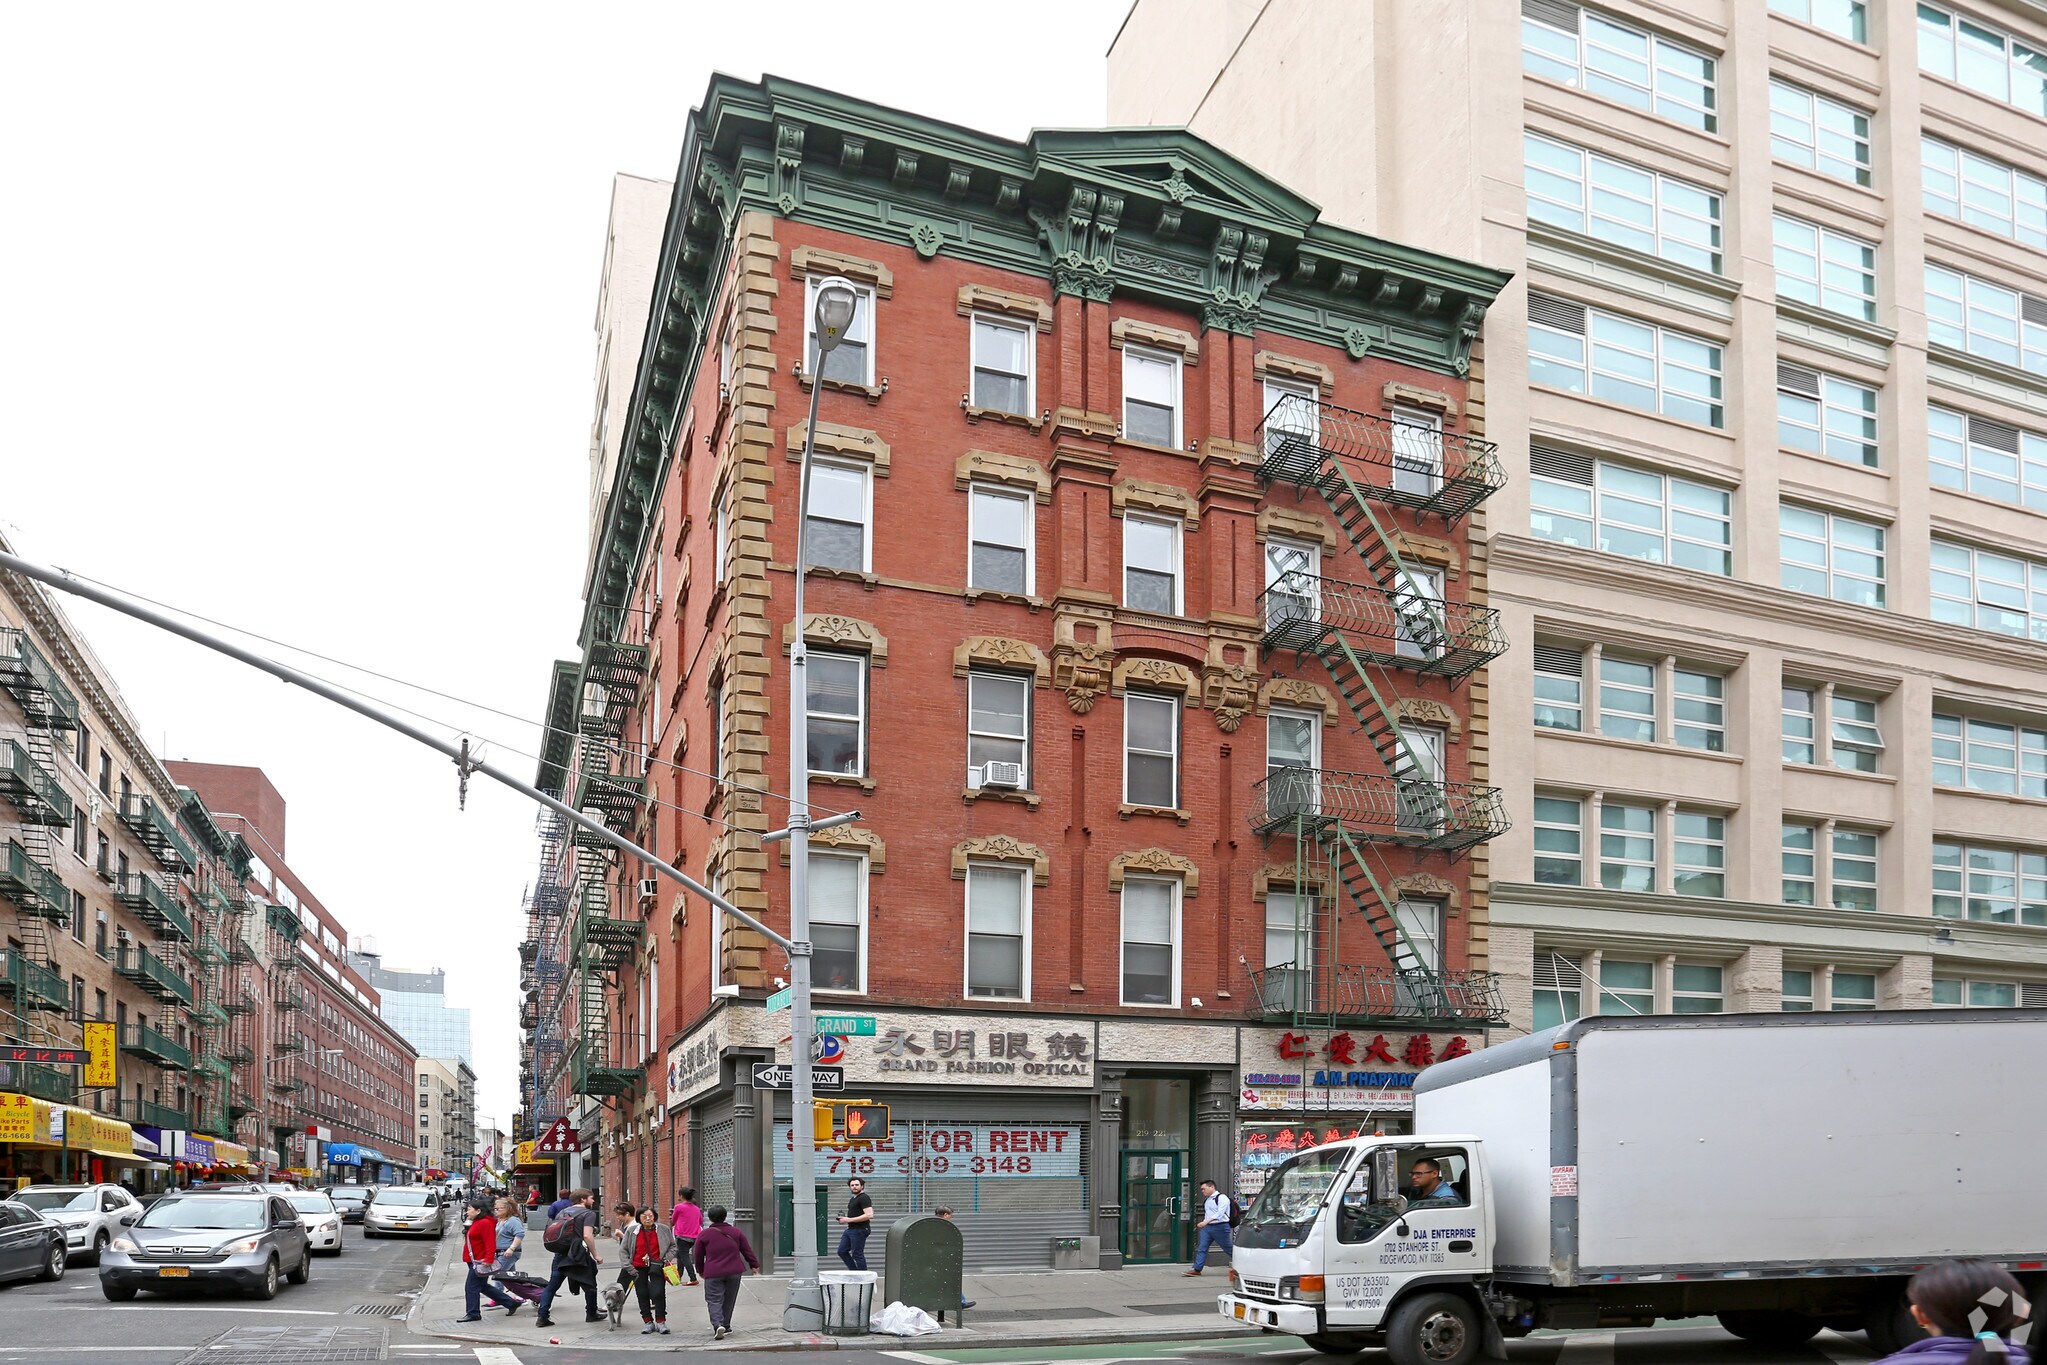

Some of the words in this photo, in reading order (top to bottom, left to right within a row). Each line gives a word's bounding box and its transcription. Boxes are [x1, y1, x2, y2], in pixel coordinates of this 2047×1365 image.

[817, 1019, 857, 1034] GRAND
[863, 1020, 873, 1028] ST
[873, 1026, 1093, 1063] 永明眼鏡
[1275, 1031, 1472, 1066] 仁愛大藥房
[13, 1049, 27, 1060] 12
[36, 1049, 51, 1061] 12
[58, 1052, 75, 1061] PM
[878, 1058, 938, 1072] GRAND
[945, 1060, 1016, 1074] FASHION
[1023, 1062, 1090, 1076] OPTICAL
[763, 1071, 792, 1082] ONE
[1313, 1070, 1346, 1086] A.M.
[1347, 1071, 1419, 1088] PHARMAC
[5, 1110, 30, 1118] Bicycle
[1136, 1129, 1149, 1137] 219
[1153, 1129, 1167, 1137] 221
[912, 1130, 973, 1153] FOR
[989, 1130, 1069, 1153] RENT
[333, 1154, 350, 1162] 80
[1247, 1152, 1276, 1166] A.M.
[826, 1156, 1032, 1174] 718-909-3148
[1414, 1229, 1427, 1240] DJA
[1431, 1228, 1476, 1239] ENTERPRISE
[1398, 1242, 1429, 1252] STANHOPE
[1431, 1241, 1441, 1252] ST.
[1379, 1253, 1418, 1265] RIDGEWOOD,
[1419, 1253, 1428, 1263] NY
[1430, 1253, 1445, 1263] 11385
[1336, 1277, 1345, 1288] US
[1347, 1277, 1360, 1287] DOT
[1363, 1276, 1389, 1286] 2635012
[1343, 1288, 1360, 1298] GVW
[1362, 1287, 1383, 1297] 12,000
[1345, 1300, 1356, 1309] MC
[1358, 1299, 1381, 1309] 917509
